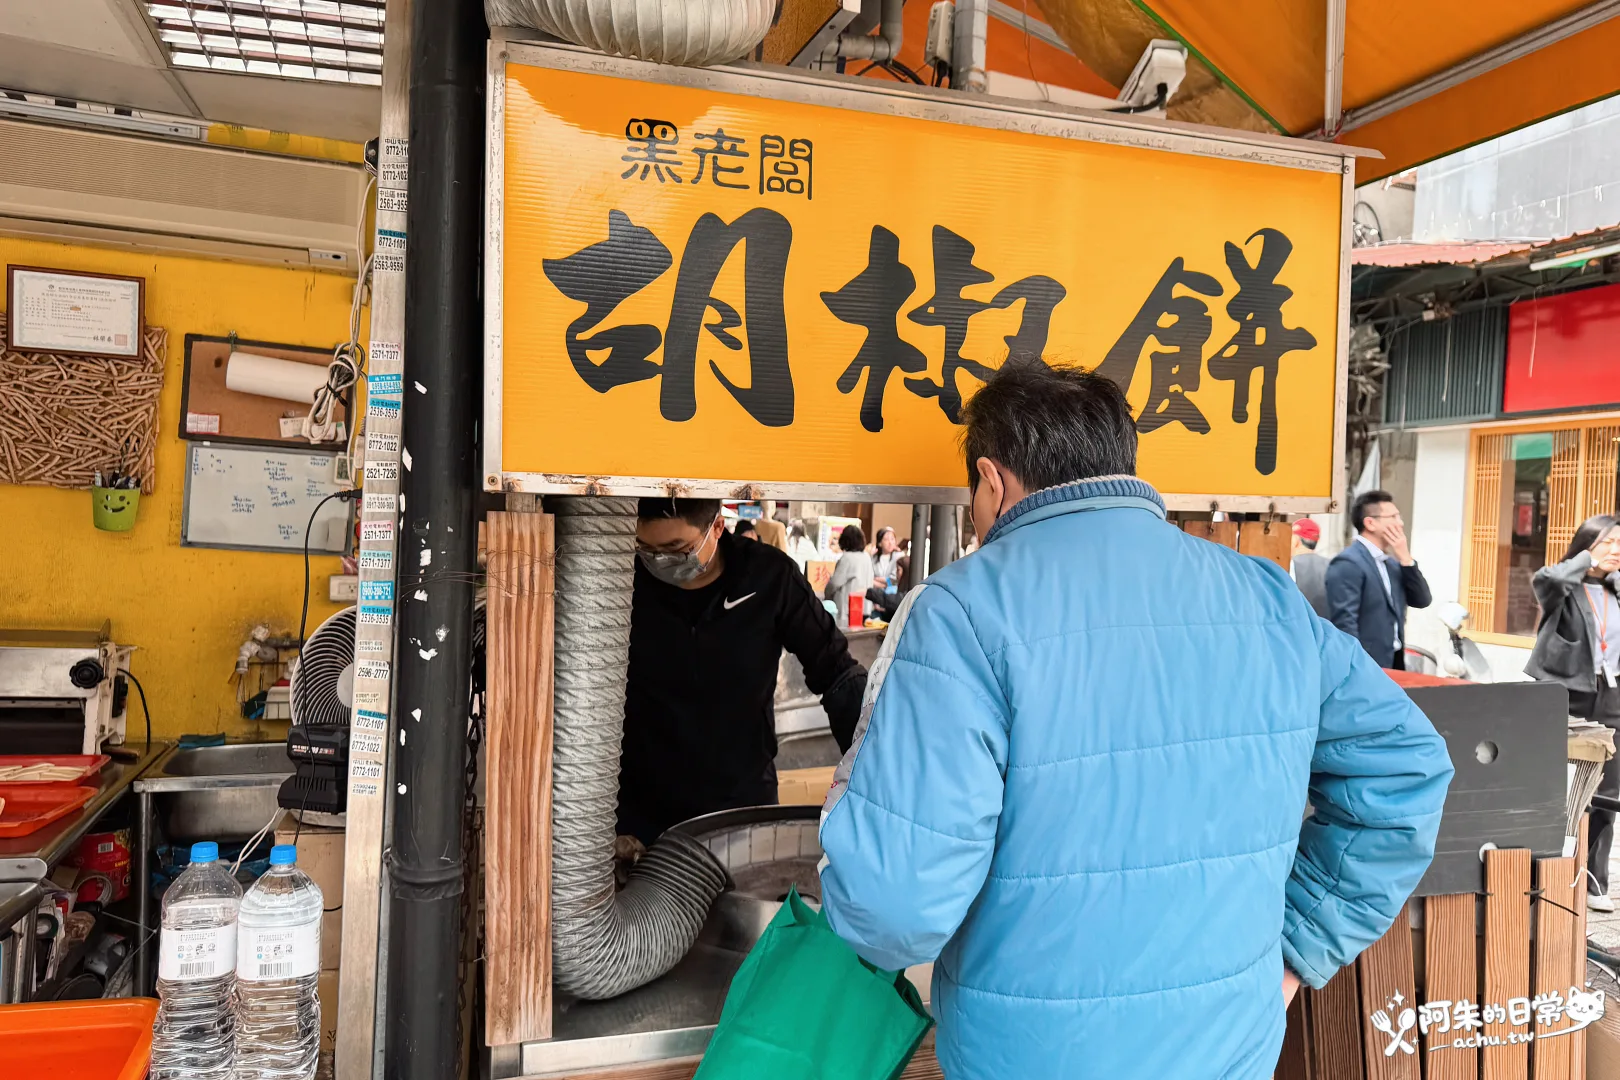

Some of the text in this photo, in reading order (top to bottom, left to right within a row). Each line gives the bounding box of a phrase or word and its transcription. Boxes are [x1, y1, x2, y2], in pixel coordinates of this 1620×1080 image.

[620, 117, 814, 200] 黑老闆
[378, 237, 406, 250] 8772-1101
[374, 261, 404, 272] 2563-9559
[541, 206, 1318, 477] 胡椒餅
[371, 349, 399, 360] 2571-7377
[369, 406, 398, 418] 2536-3535
[368, 440, 397, 452] 8772-1022
[366, 468, 397, 479] 2521-7236
[364, 530, 392, 540] 2571-7377
[361, 557, 391, 568] 2571-7377
[360, 613, 390, 625] 2536-3535
[351, 740, 380, 753] 8772-1022
